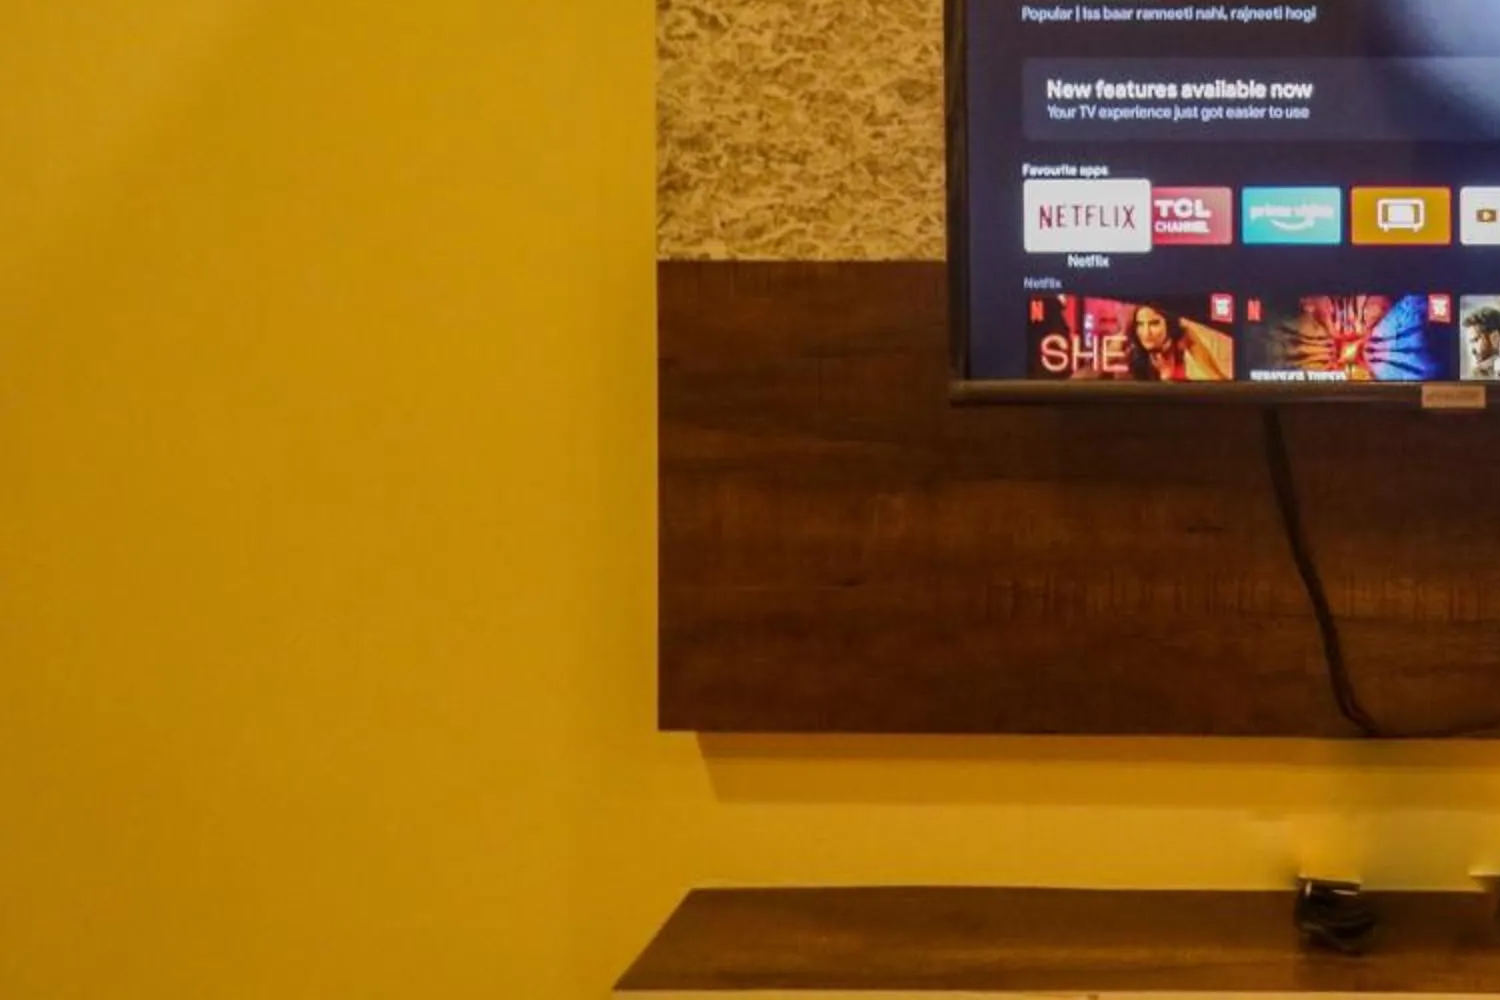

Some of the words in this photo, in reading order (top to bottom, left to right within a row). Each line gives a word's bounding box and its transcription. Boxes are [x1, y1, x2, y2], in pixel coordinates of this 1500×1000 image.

[1022, 5, 1073, 22] Popular
[1285, 5, 1317, 23] hogi
[1047, 79, 1091, 99] New
[1096, 78, 1178, 99] features
[1181, 79, 1267, 99] available
[1270, 83, 1314, 99] now
[1047, 104, 1077, 119] Your
[1080, 104, 1097, 119] TV
[1098, 104, 1172, 121] experience
[1173, 104, 1198, 121] just
[1201, 105, 1223, 121] got
[1225, 105, 1267, 119] easier
[1269, 105, 1283, 119] to
[1285, 107, 1310, 119] use
[1022, 163, 1078, 177] Favourite
[1079, 165, 1109, 179] apps
[1154, 198, 1212, 218] TCL
[1039, 205, 1136, 230] NETFLIX
[1154, 220, 1211, 233] CHANNEL
[1067, 254, 1110, 269] Netflix
[1041, 334, 1129, 372] SHE
